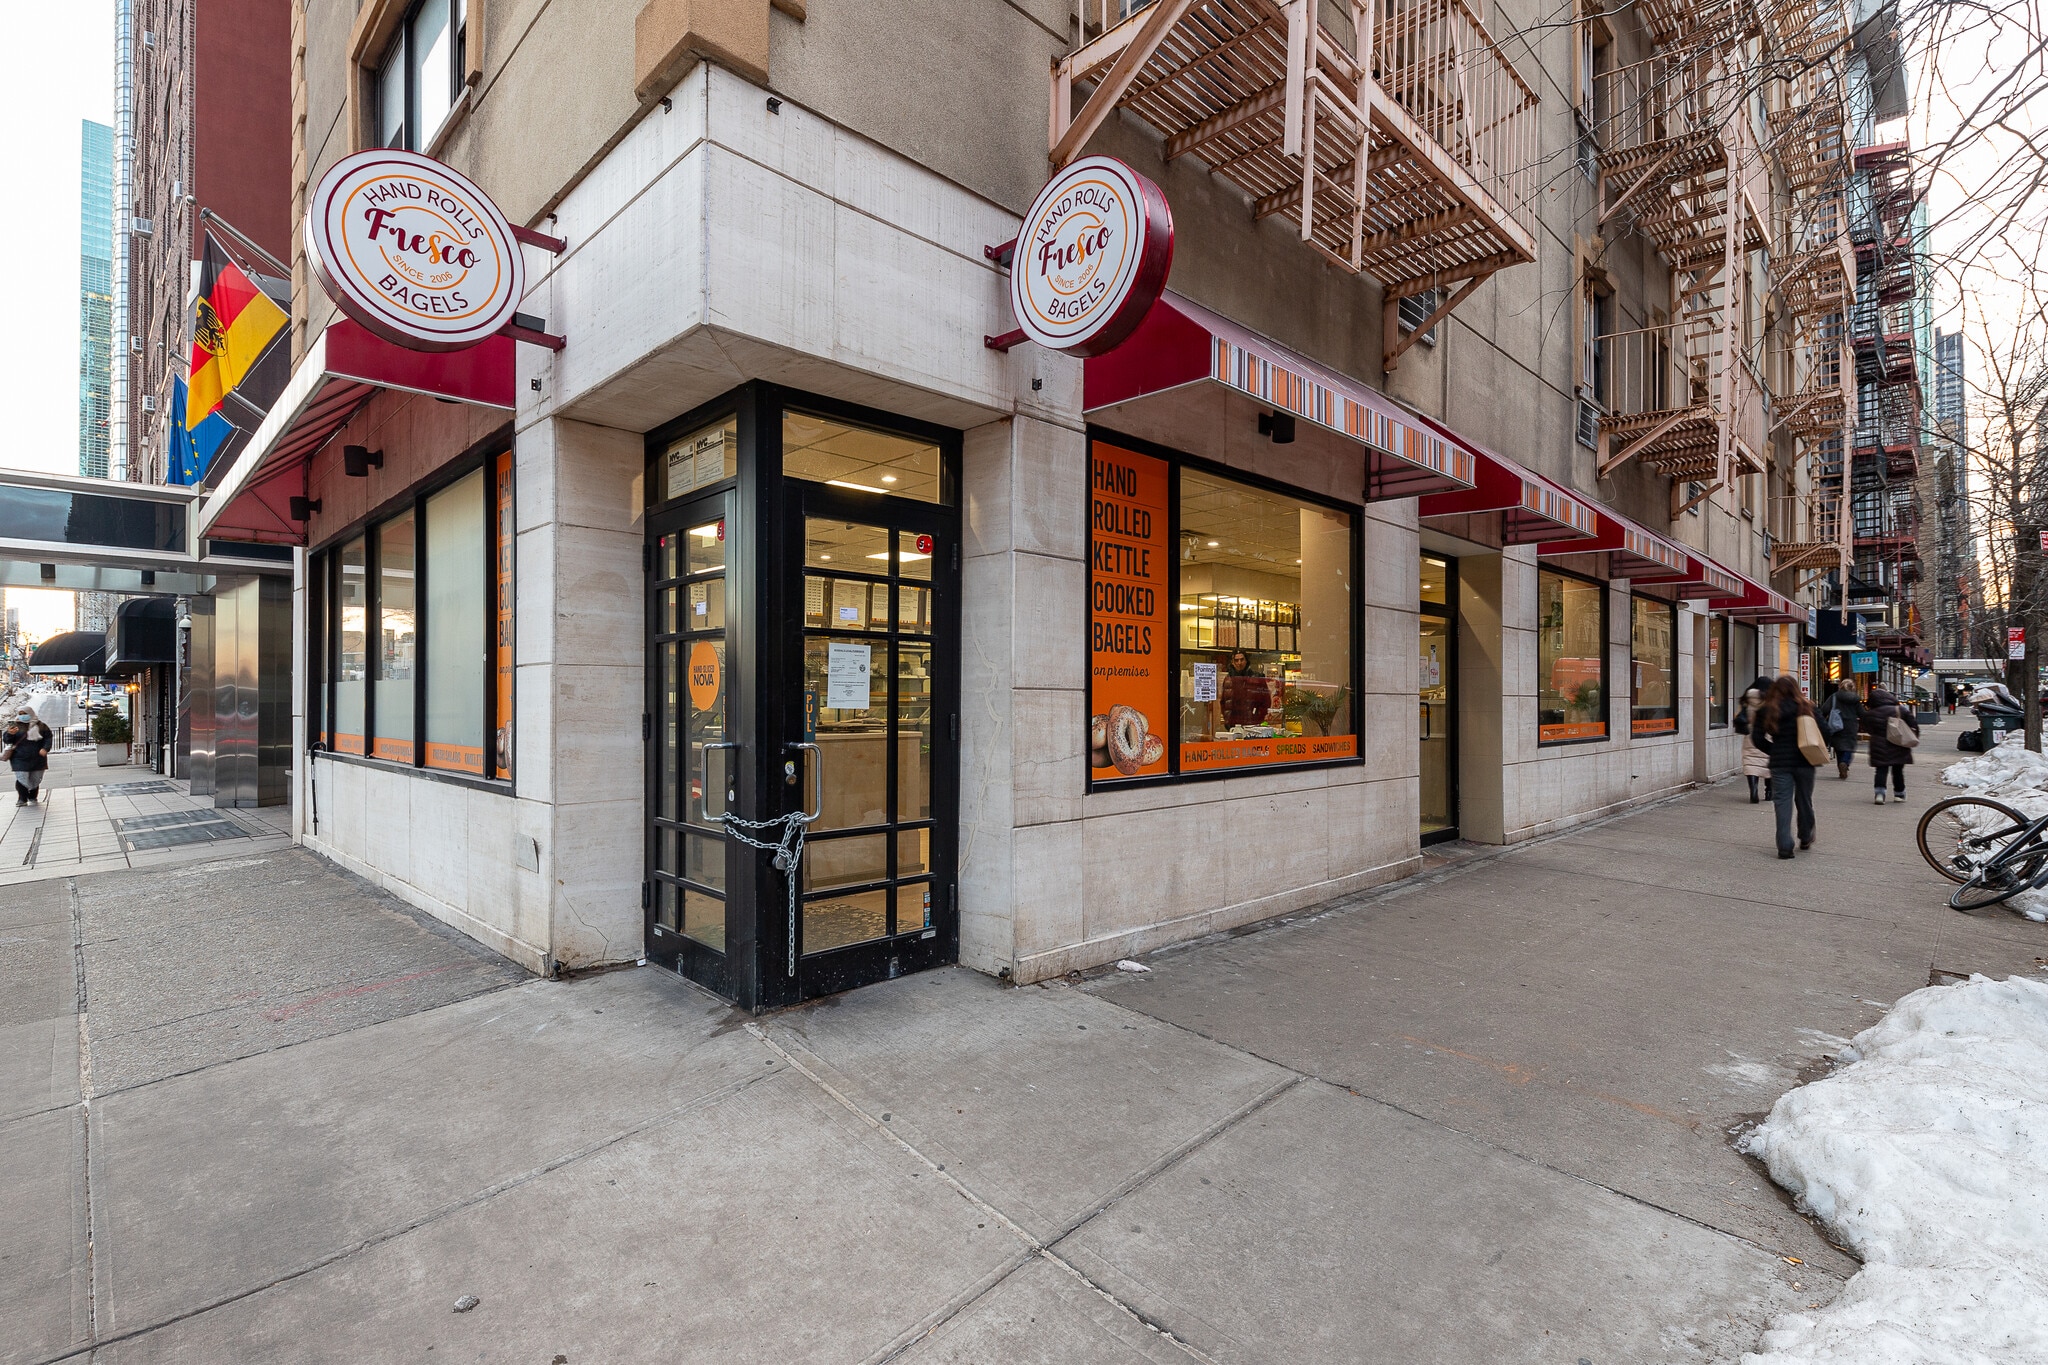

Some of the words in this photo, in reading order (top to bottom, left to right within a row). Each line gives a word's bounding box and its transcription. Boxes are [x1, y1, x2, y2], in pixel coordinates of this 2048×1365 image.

[362, 182, 422, 207] HAND
[427, 189, 484, 240] ROLLS
[1036, 197, 1072, 243] HAND
[1074, 188, 1115, 213] ROLLS
[364, 207, 481, 269] Fresco
[1038, 226, 1113, 277] Fresco
[392, 253, 424, 281] SINCE
[430, 271, 453, 283] 2006
[1054, 274, 1074, 289] SINCE
[1077, 263, 1094, 285] 2006
[378, 273, 469, 313] BAGELS
[1047, 277, 1105, 319] BAGELS
[696, 437, 708, 449] NYC
[1094, 458, 1137, 497] HAND
[1094, 500, 1151, 540] ROLLED
[1094, 540, 1150, 577] KETTLE
[1094, 581, 1155, 617] COOKED
[1094, 621, 1151, 655] BAGELS
[693, 673, 715, 686] NOVA
[1801, 654, 1809, 681] SHOES
[1184, 748, 1239, 763] HAND-ROLLED
[1242, 746, 1270, 758] BAGELS
[1276, 744, 1306, 755] SPREADS
[1312, 741, 1351, 754] SANDWICHES
